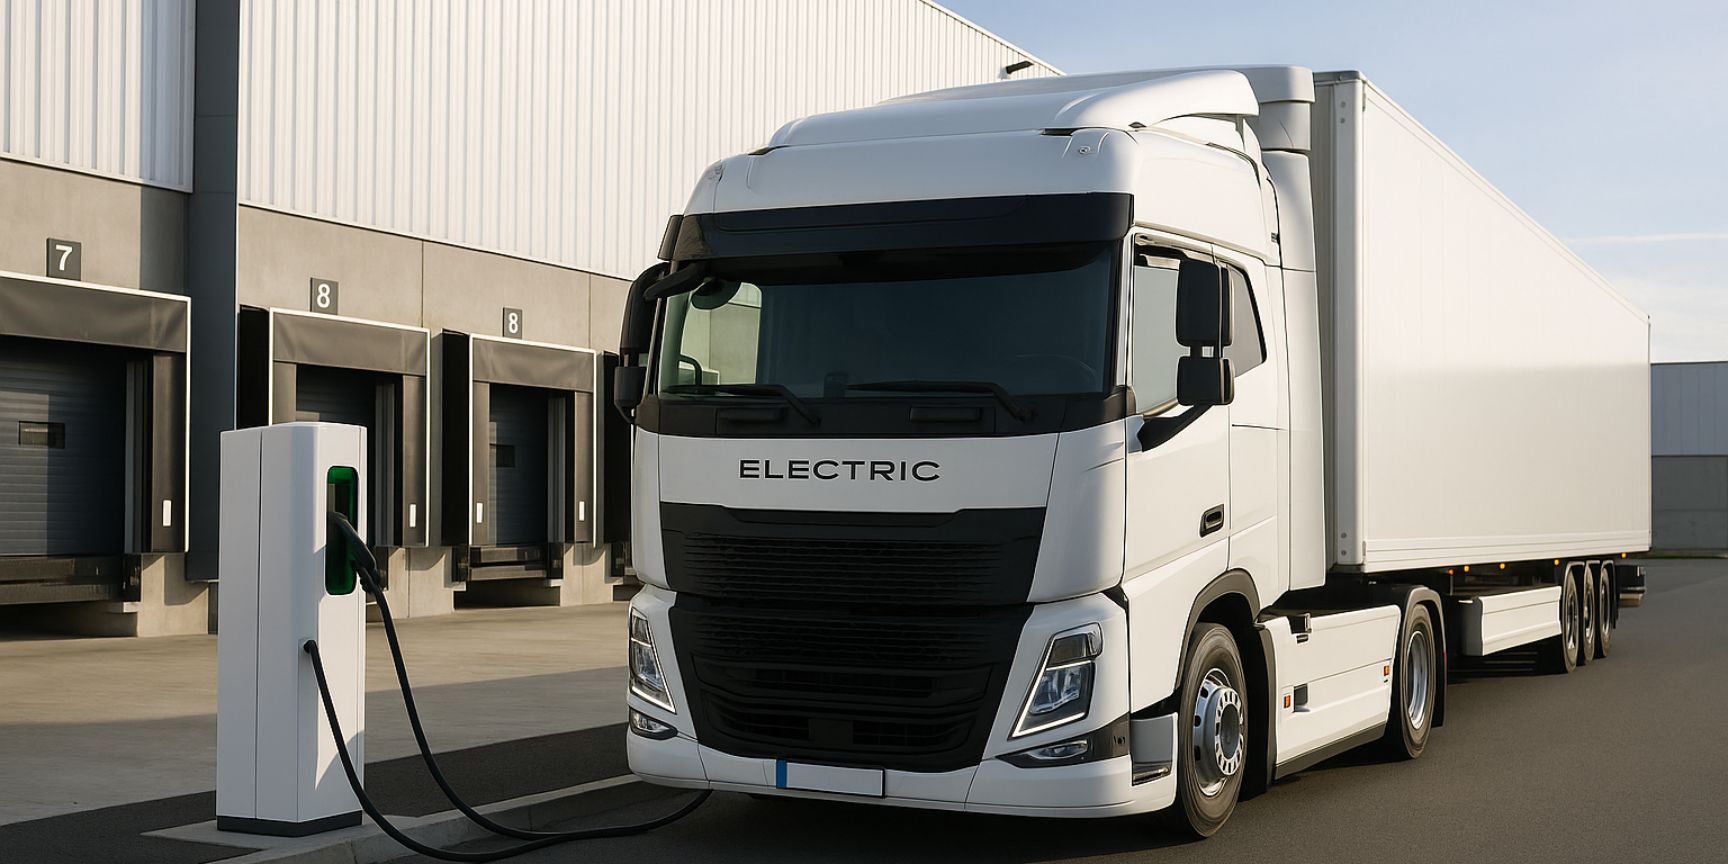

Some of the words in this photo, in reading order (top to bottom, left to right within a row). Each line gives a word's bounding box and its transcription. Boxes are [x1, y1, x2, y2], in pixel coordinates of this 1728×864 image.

[55, 244, 73, 271] 7
[316, 283, 331, 308] 8
[508, 312, 519, 334] 8
[739, 459, 940, 482] ELECTRIC
